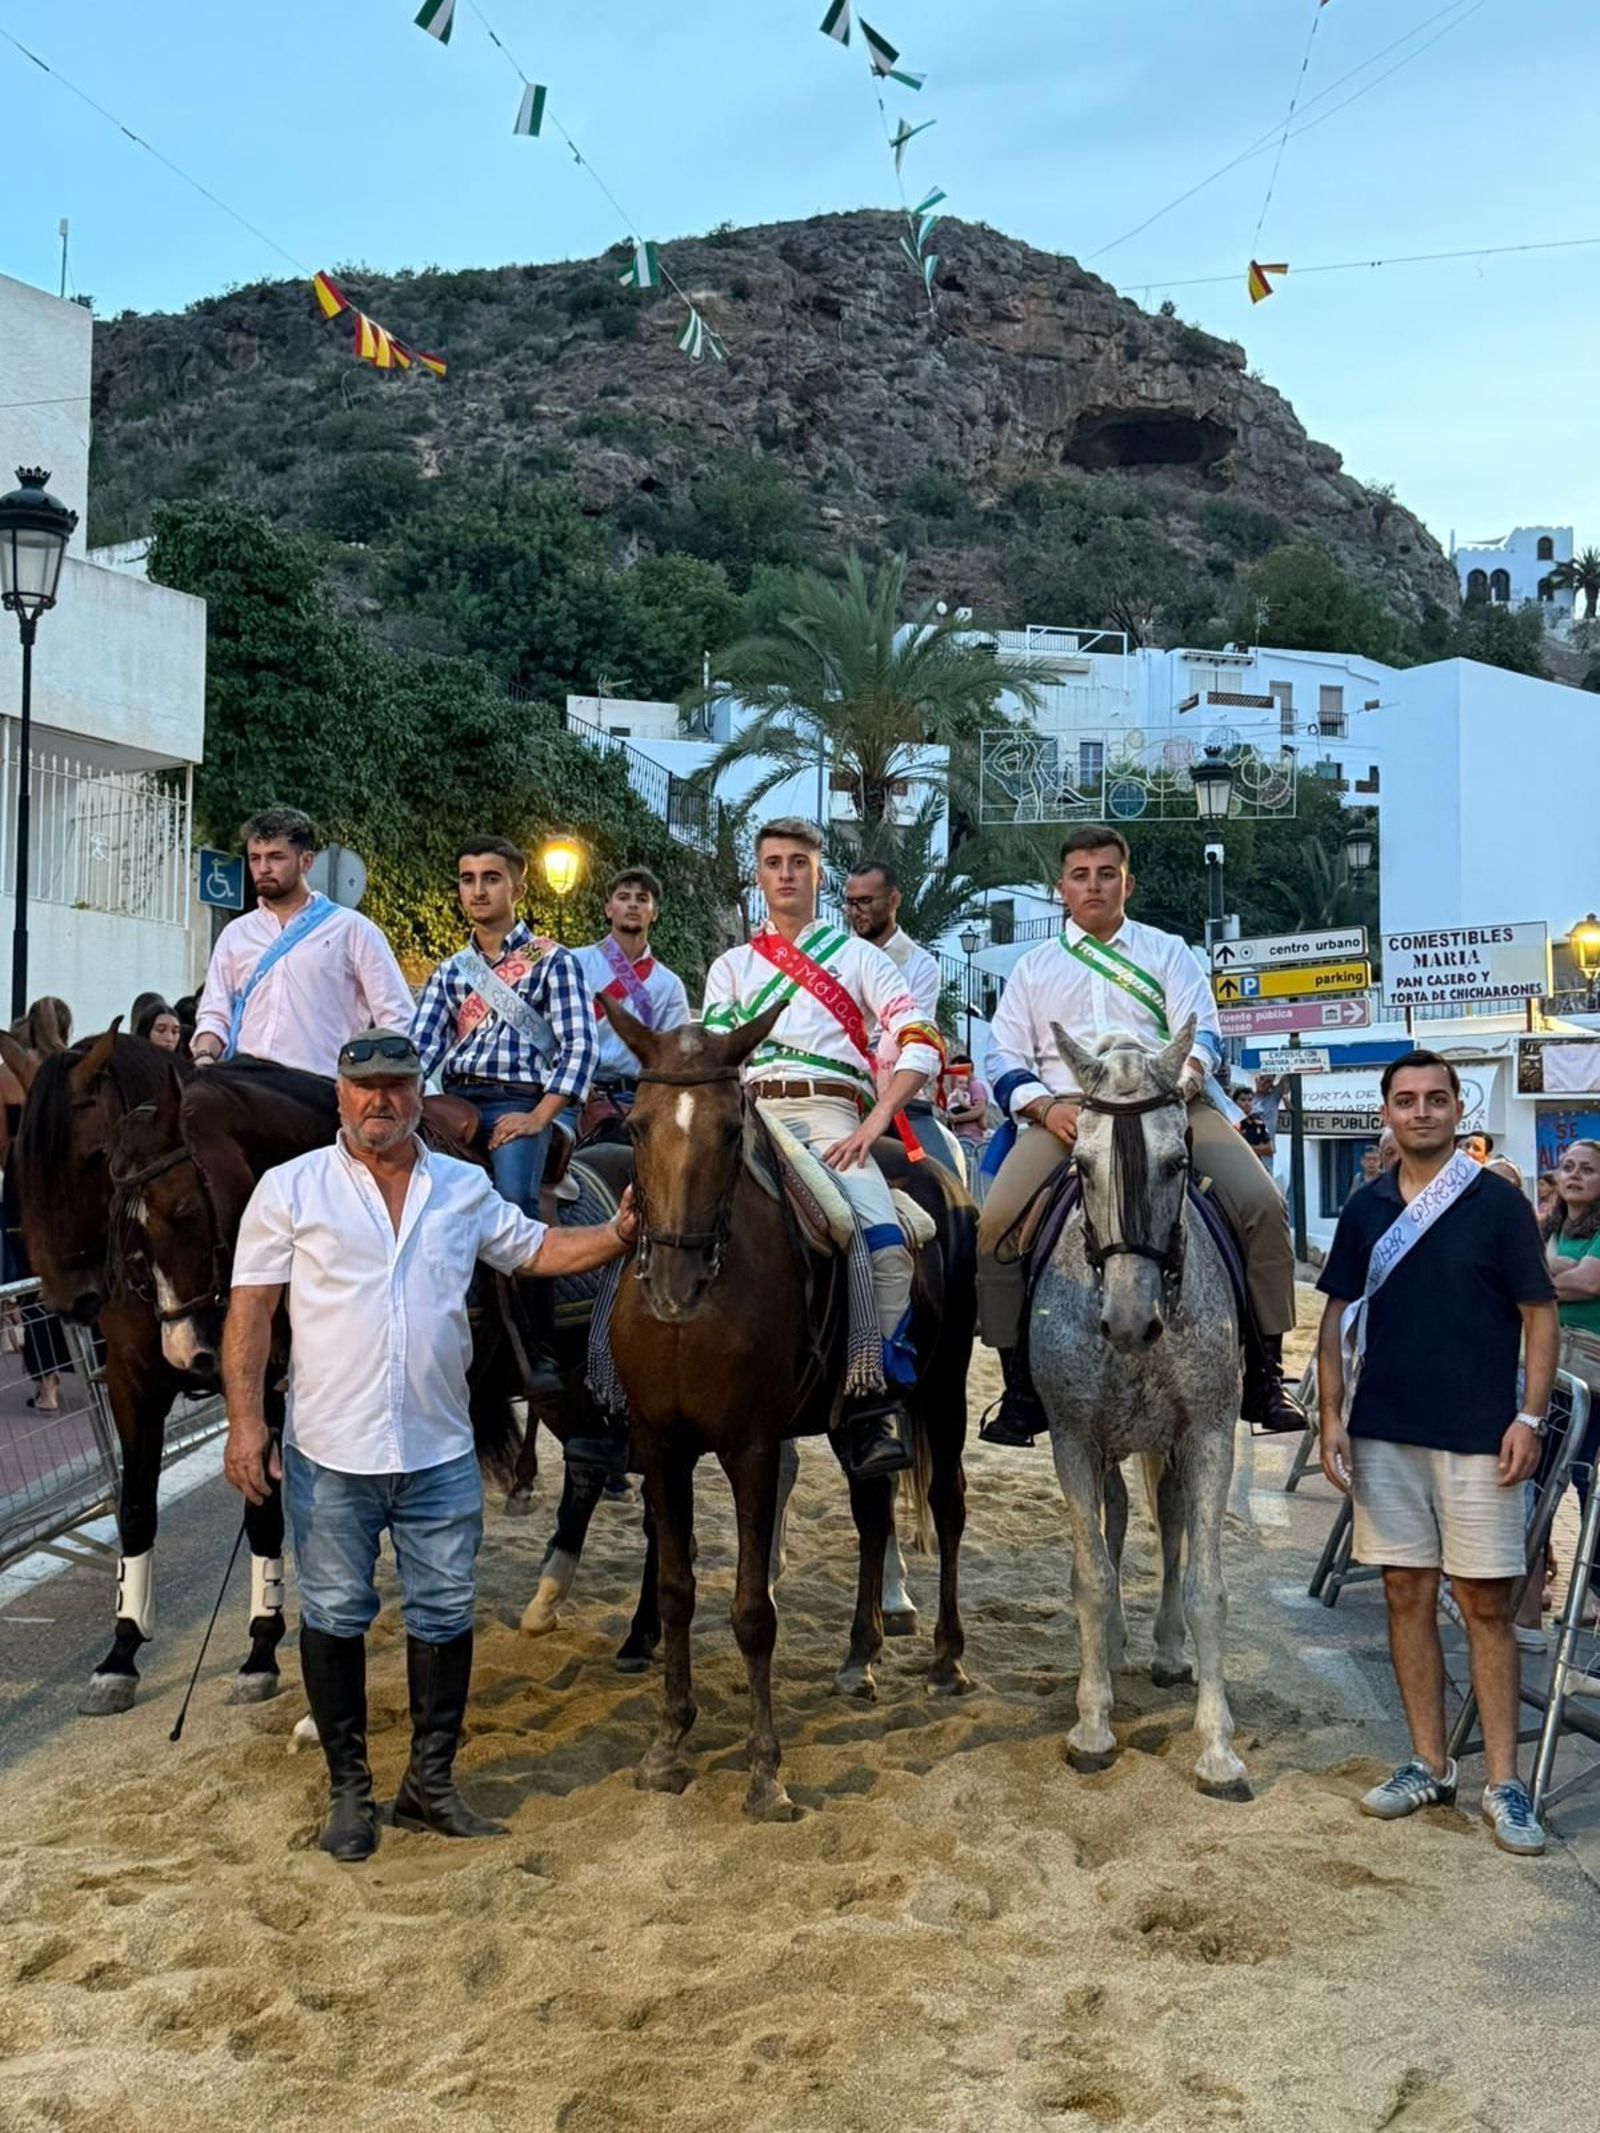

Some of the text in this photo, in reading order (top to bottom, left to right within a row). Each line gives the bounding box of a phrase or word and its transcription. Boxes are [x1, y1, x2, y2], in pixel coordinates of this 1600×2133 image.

[1269, 937, 1361, 956] centro urbano
[1388, 927, 1514, 951] COMESTIBLES
[1315, 971, 1363, 988] parking
[1396, 970, 1491, 989] PAN CASERO Y
[1390, 982, 1543, 1004] TORTA DE CHICHARRONES
[1219, 1012, 1252, 1024] fuente
[1355, 1089, 1377, 1099] DE
